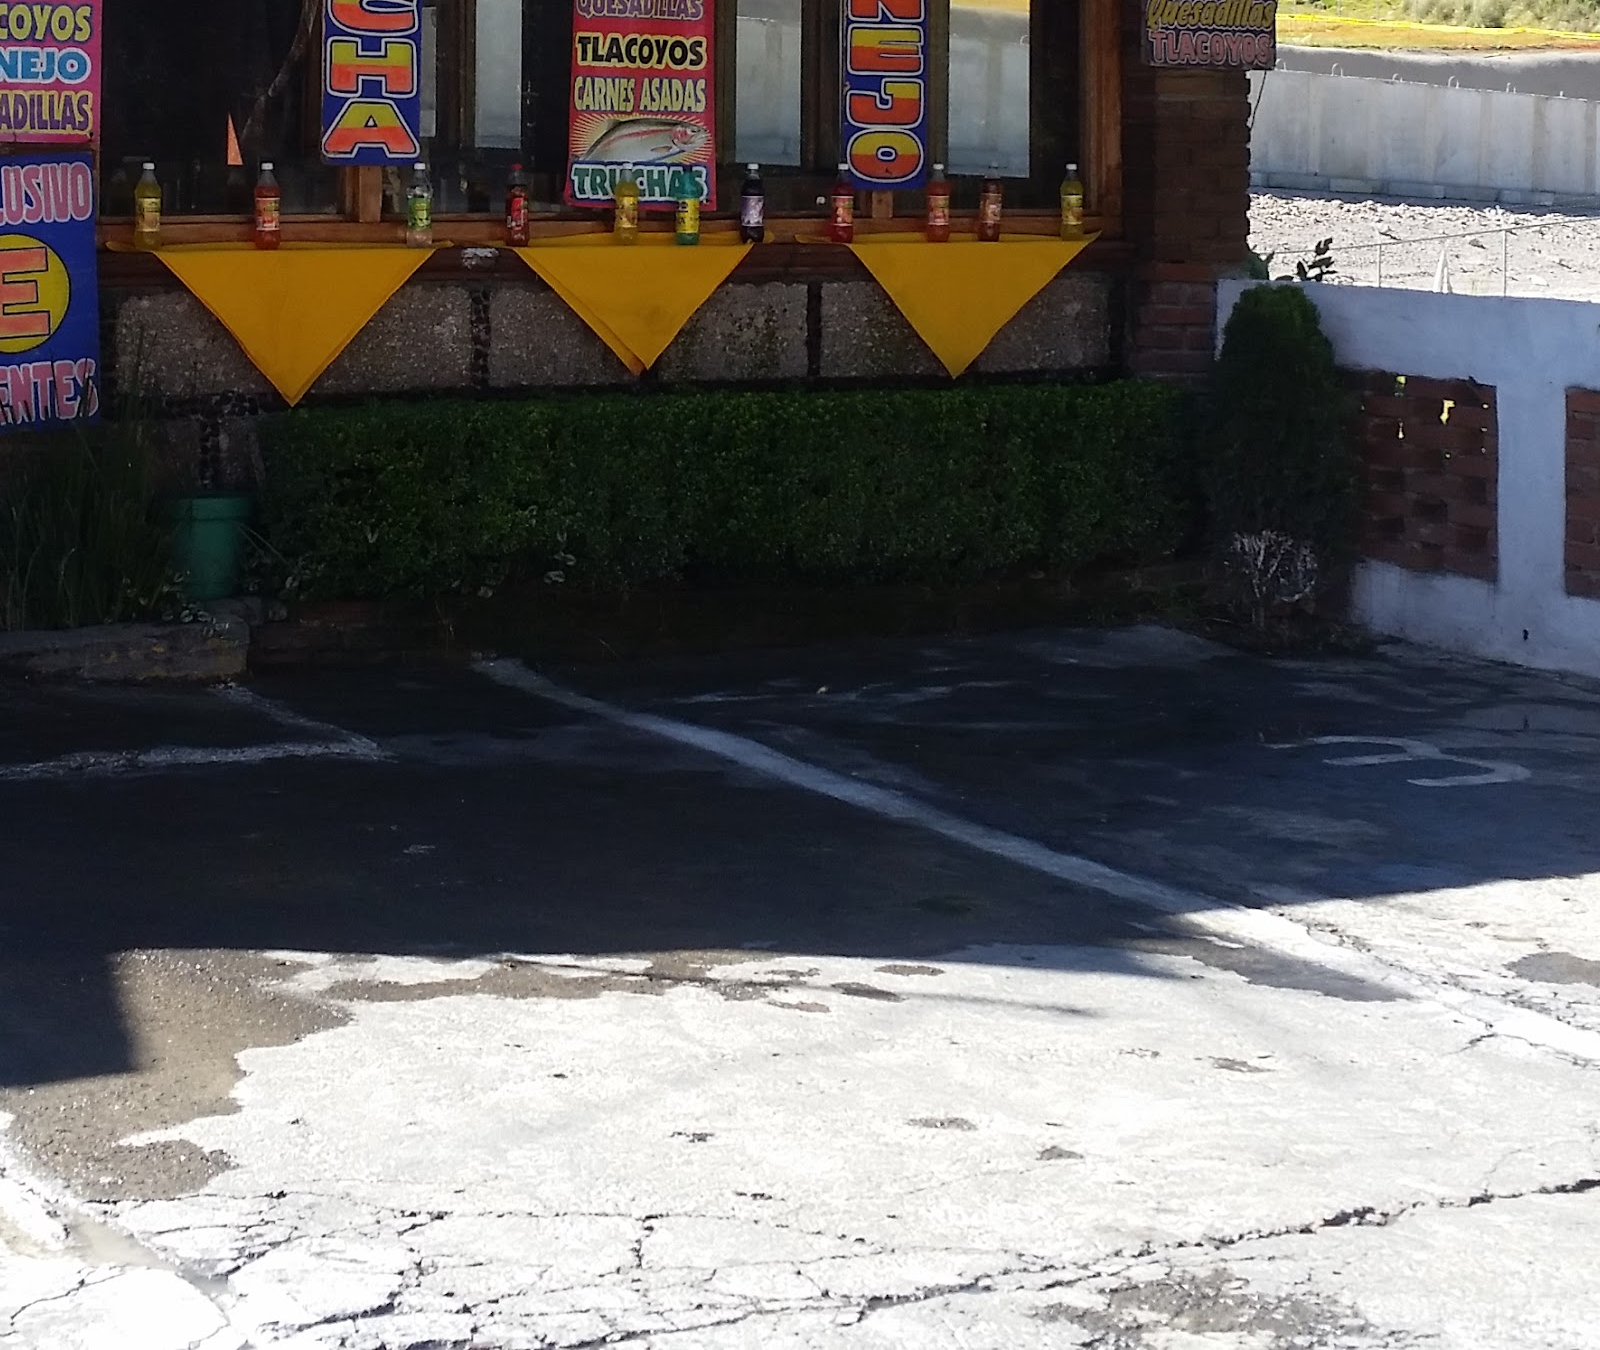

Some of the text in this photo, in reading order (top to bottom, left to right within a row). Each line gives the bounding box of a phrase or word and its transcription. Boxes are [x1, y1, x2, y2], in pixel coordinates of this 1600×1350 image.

[574, 32, 707, 70] TLACOYOS
[1149, 30, 1274, 66] TLACOYOS
[574, 76, 707, 113] CARNES ASADAS
